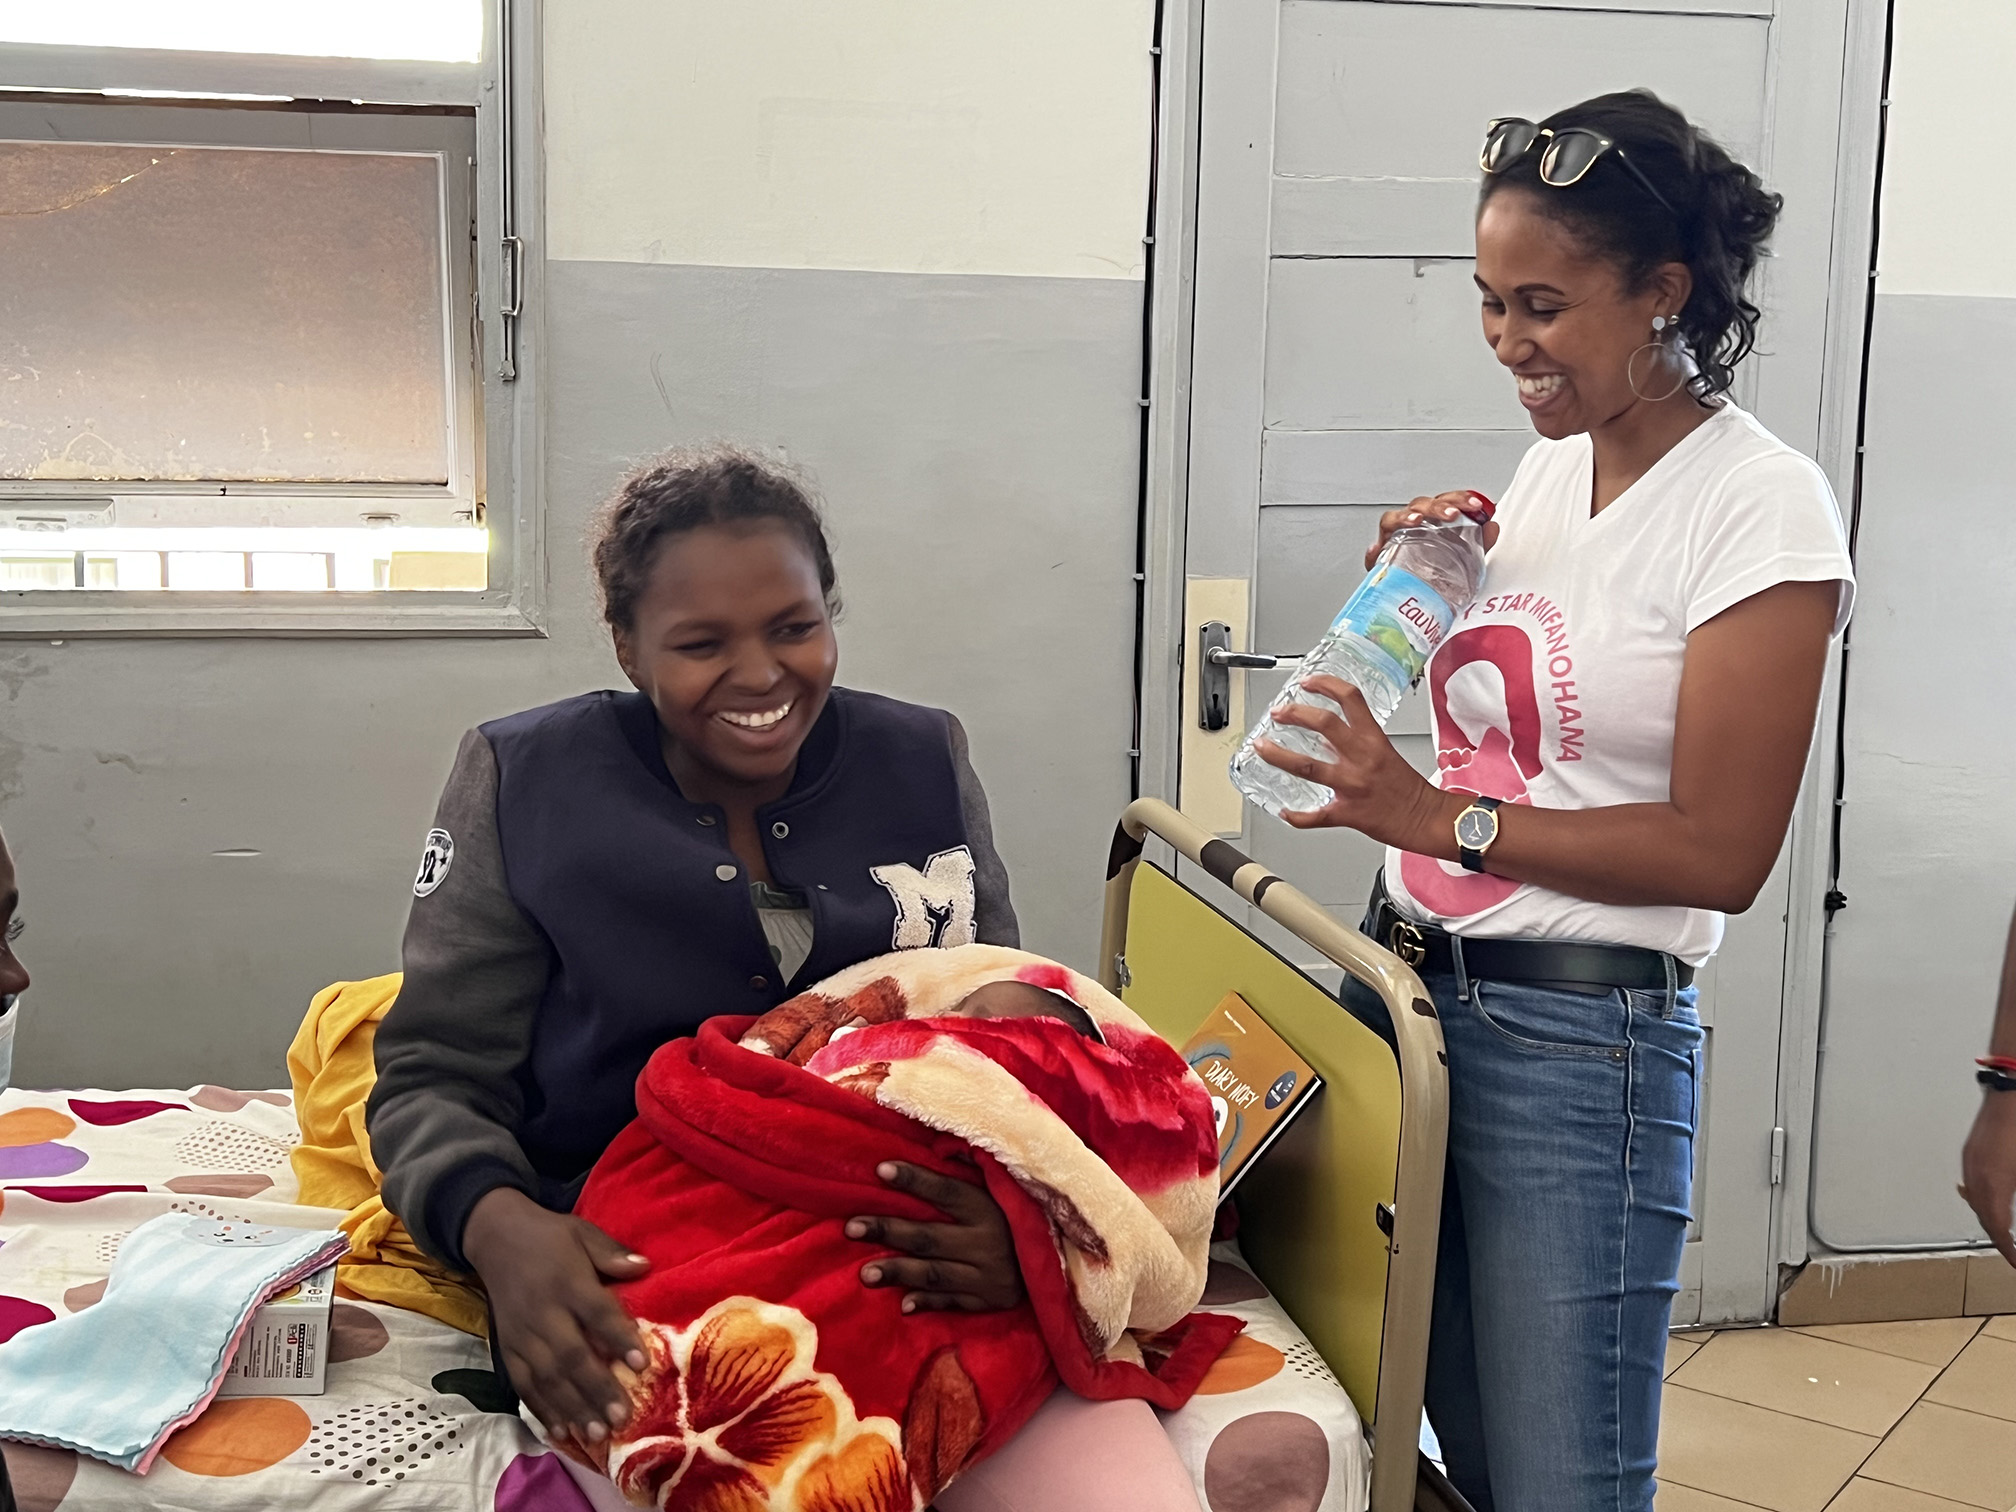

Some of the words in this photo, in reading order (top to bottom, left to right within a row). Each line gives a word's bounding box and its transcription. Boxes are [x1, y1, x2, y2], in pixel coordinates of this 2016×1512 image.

[1482, 592, 1535, 614] STAR
[1528, 596, 1585, 762] MIFANOHANA
[869, 844, 978, 950] M
